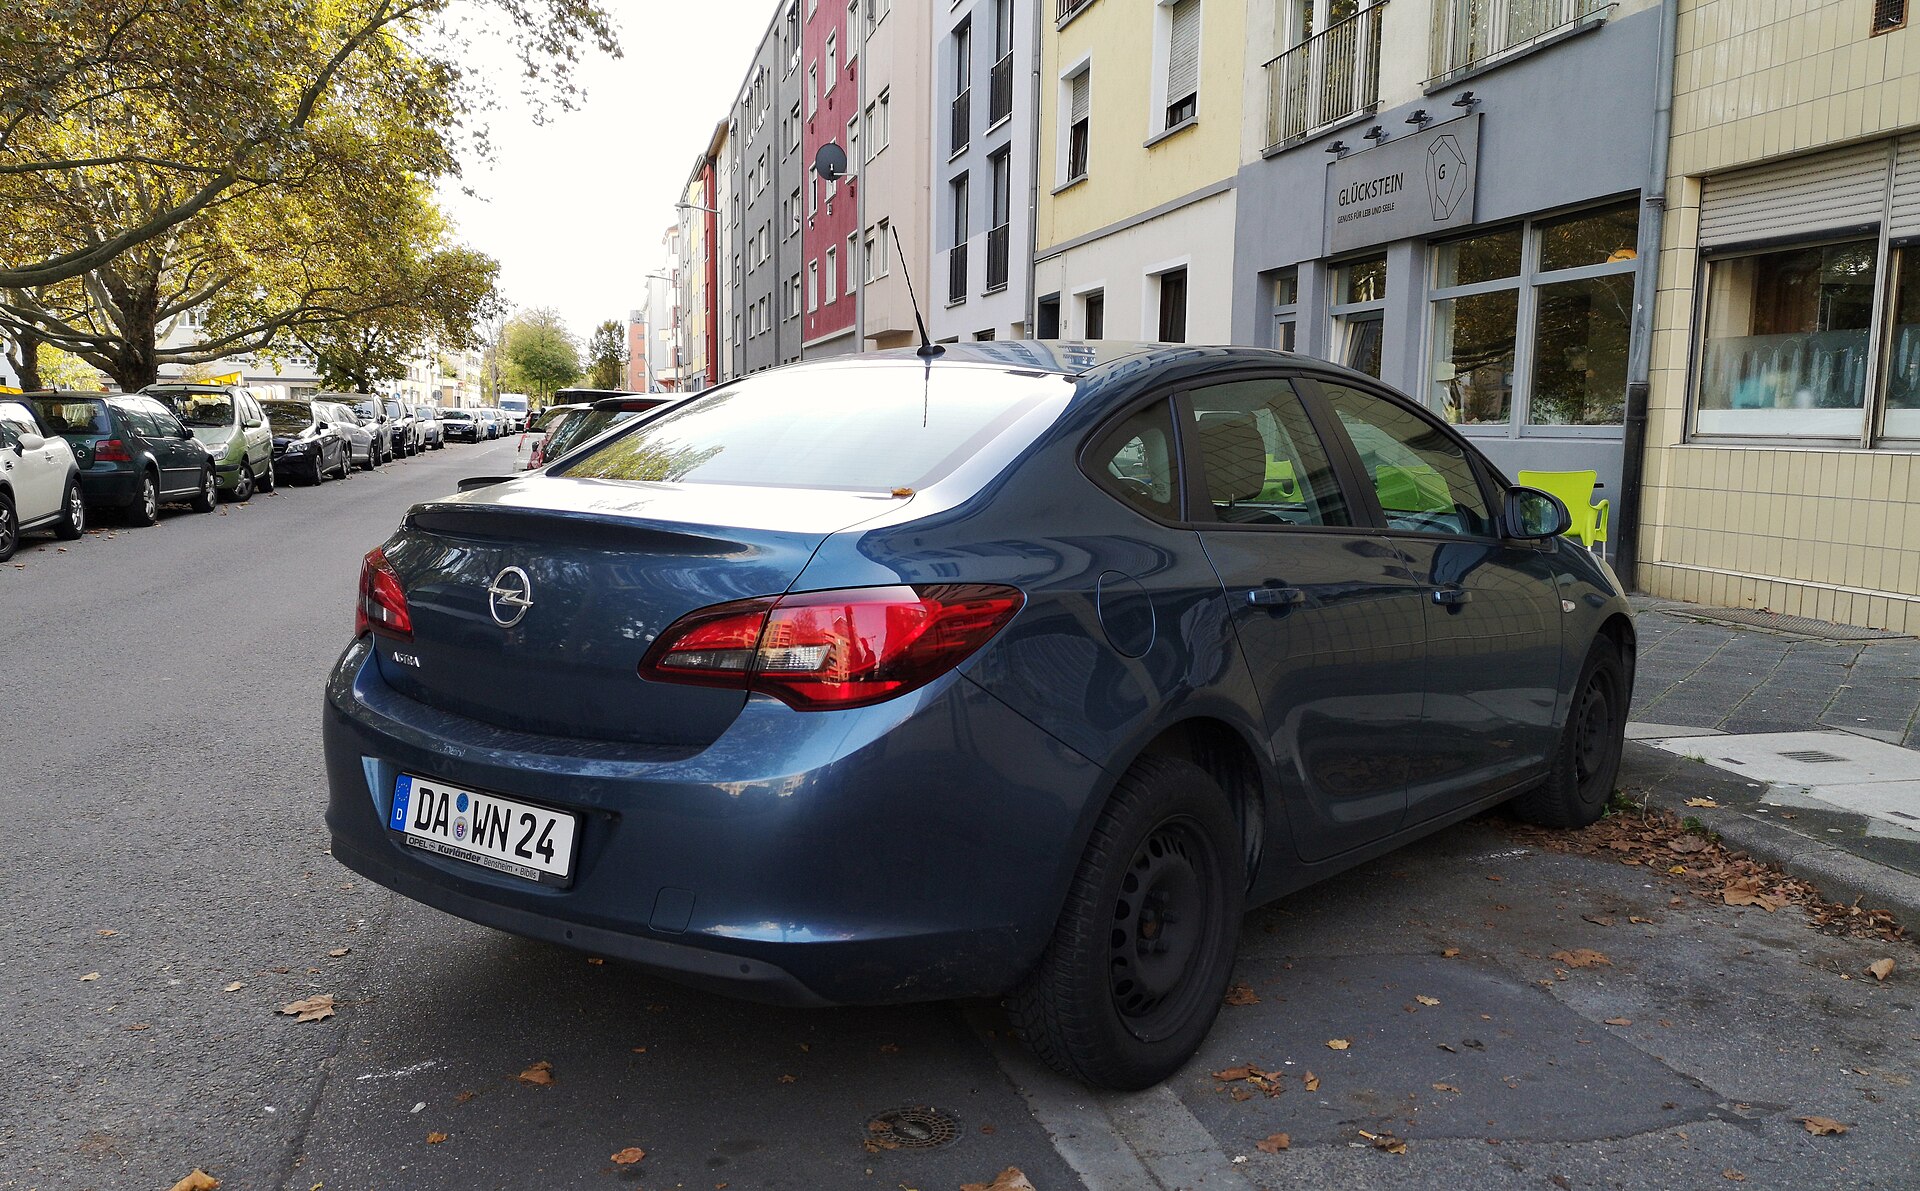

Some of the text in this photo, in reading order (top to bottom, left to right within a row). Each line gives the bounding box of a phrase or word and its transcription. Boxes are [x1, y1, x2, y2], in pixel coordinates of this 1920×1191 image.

[1338, 172, 1404, 206] GLÜCKSTEIN
[1438, 164, 1446, 180] G
[1337, 202, 1394, 224] GENUSS FÜR LEIB UND SEELE
[396, 786, 557, 864] D DA WN 24
[408, 836, 537, 880] OPEL Kurländer Bensheim Biblis
